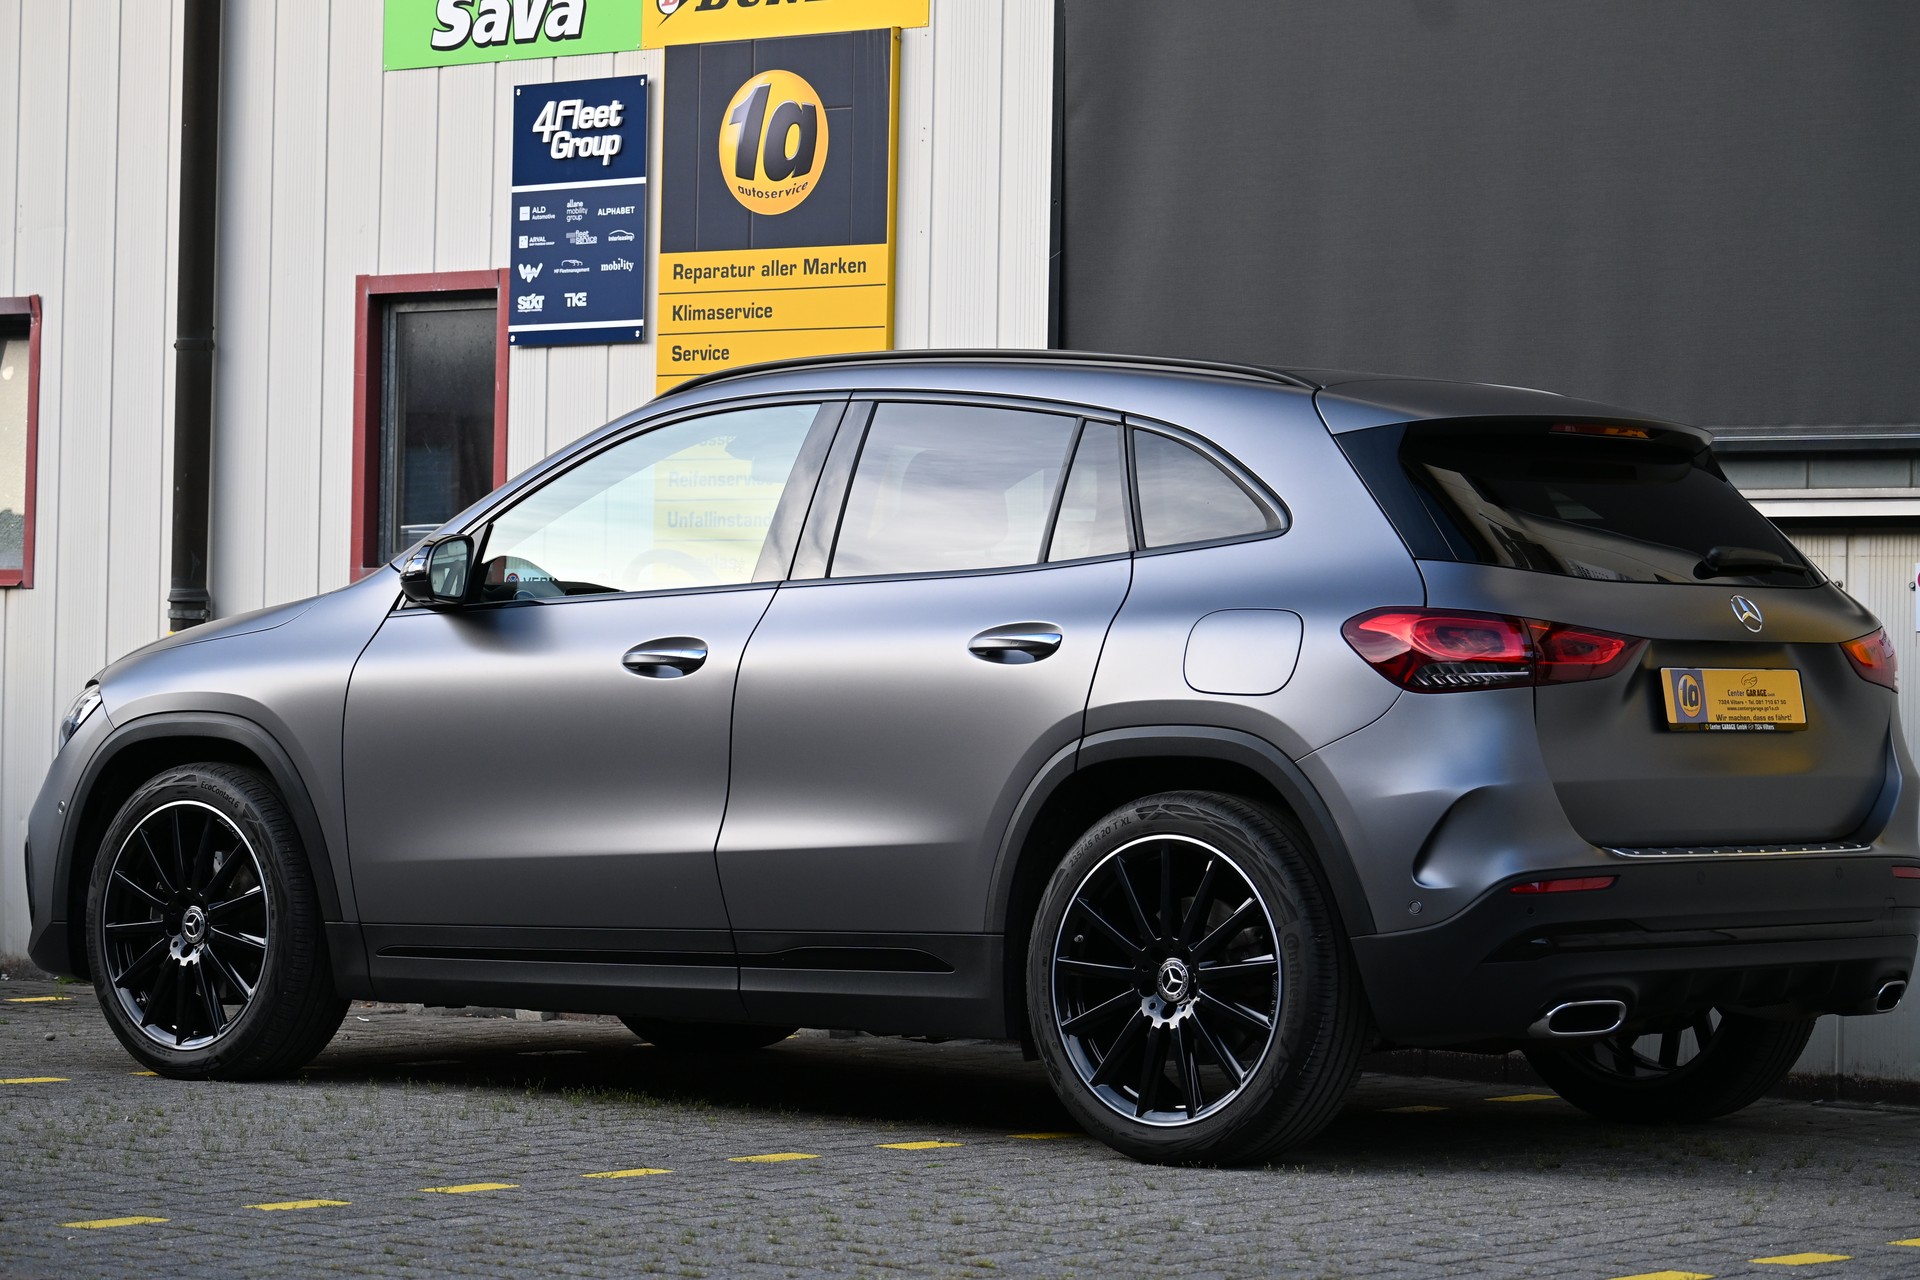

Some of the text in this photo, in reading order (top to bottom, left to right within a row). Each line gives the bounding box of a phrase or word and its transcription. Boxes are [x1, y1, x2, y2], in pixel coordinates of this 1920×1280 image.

[532, 99, 624, 143] 4Fleet
[729, 82, 818, 182] 1a
[551, 131, 622, 166] Group
[738, 181, 808, 199] autoservice
[532, 206, 546, 214] ALD
[566, 214, 583, 222] group
[598, 206, 635, 216] ALPHABET
[600, 257, 634, 272] mobility
[673, 257, 867, 284] Reparatur aller Marken
[672, 302, 773, 321] Klimaservice
[672, 344, 730, 362] Service
[200, 780, 236, 806] EcoContact
[1069, 839, 1094, 867] 235/45
[1120, 816, 1132, 827] XL
